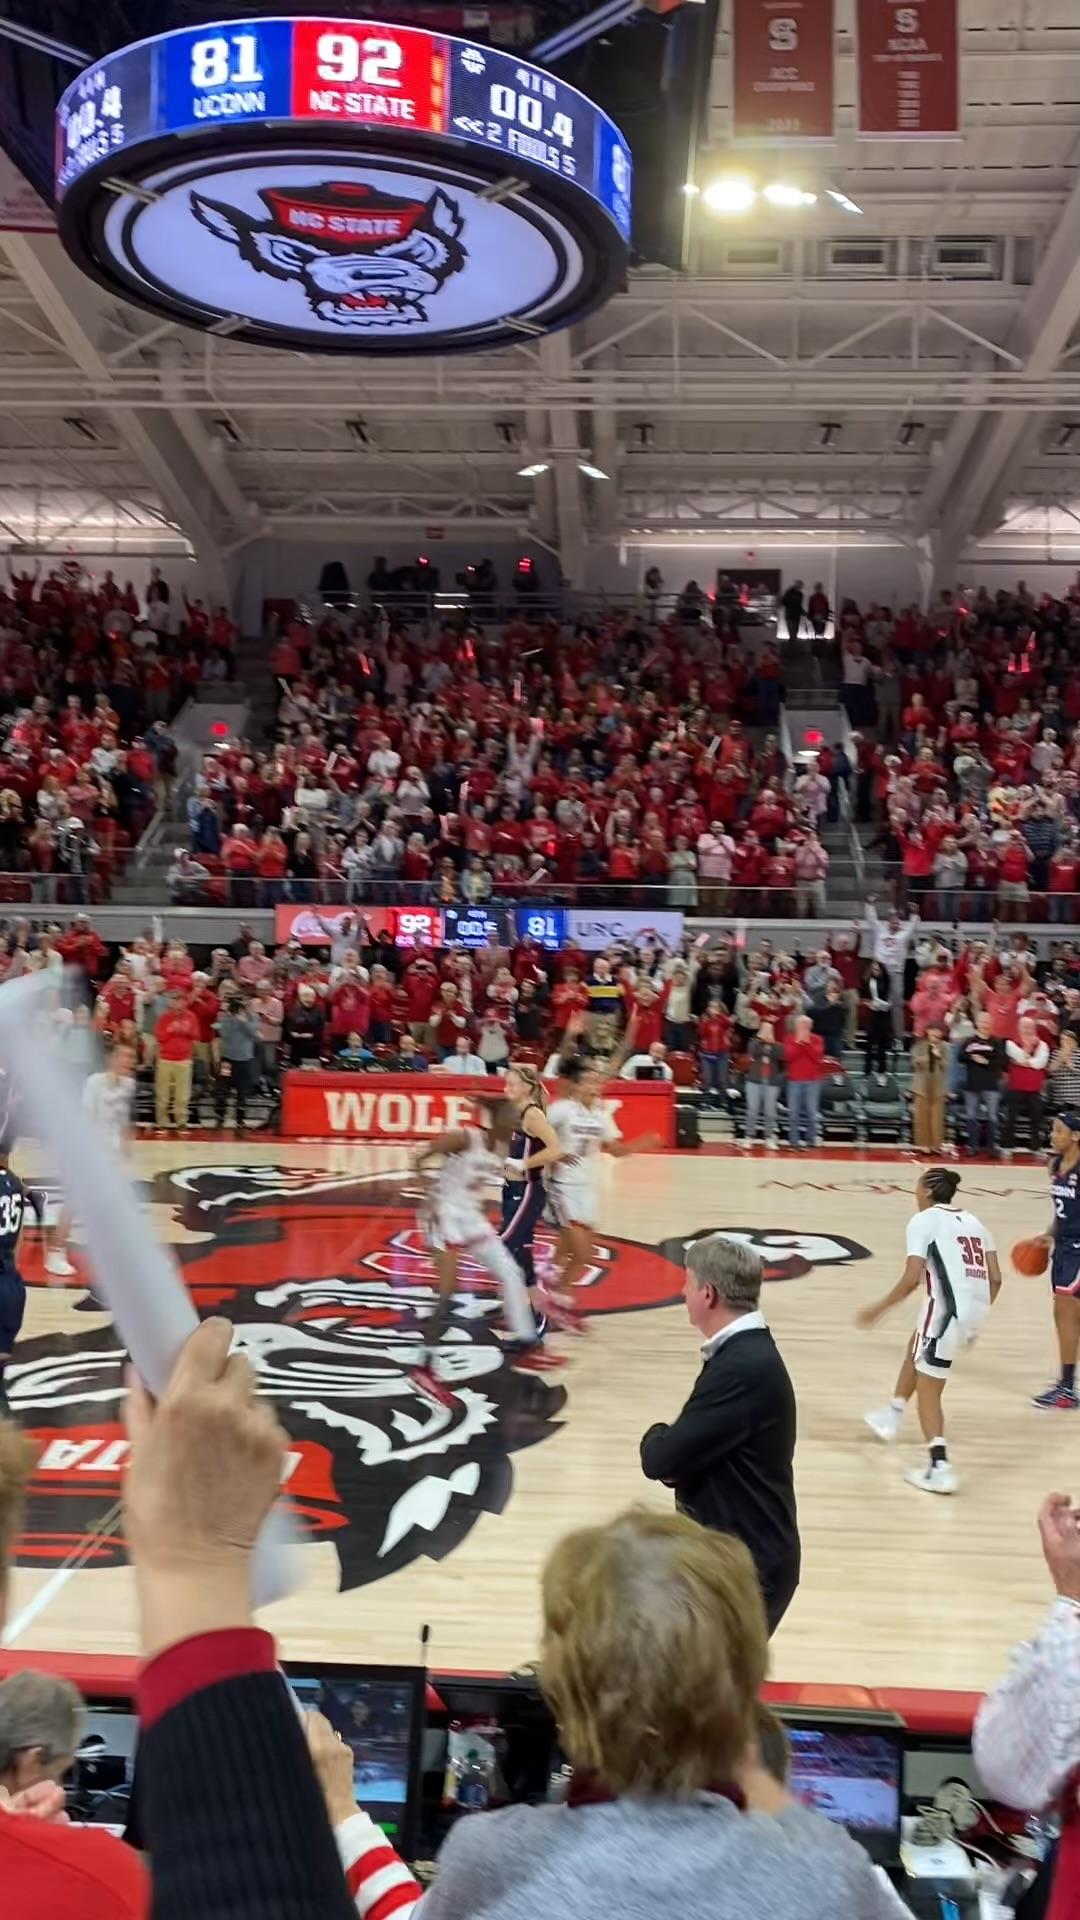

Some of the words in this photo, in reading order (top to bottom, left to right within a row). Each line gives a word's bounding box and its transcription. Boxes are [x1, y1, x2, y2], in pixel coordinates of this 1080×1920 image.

[191, 35, 264, 88] 81
[316, 34, 403, 88] 92
[193, 91, 266, 119] UCONN
[309, 89, 343, 112] NC
[344, 93, 416, 121] STATE
[489, 83, 575, 149] 00.4
[327, 215, 402, 236] STATE
[400, 914, 432, 934] 92
[528, 916, 557, 937] 81
[0, 1192, 22, 1236] 35
[957, 1235, 984, 1267] 35
